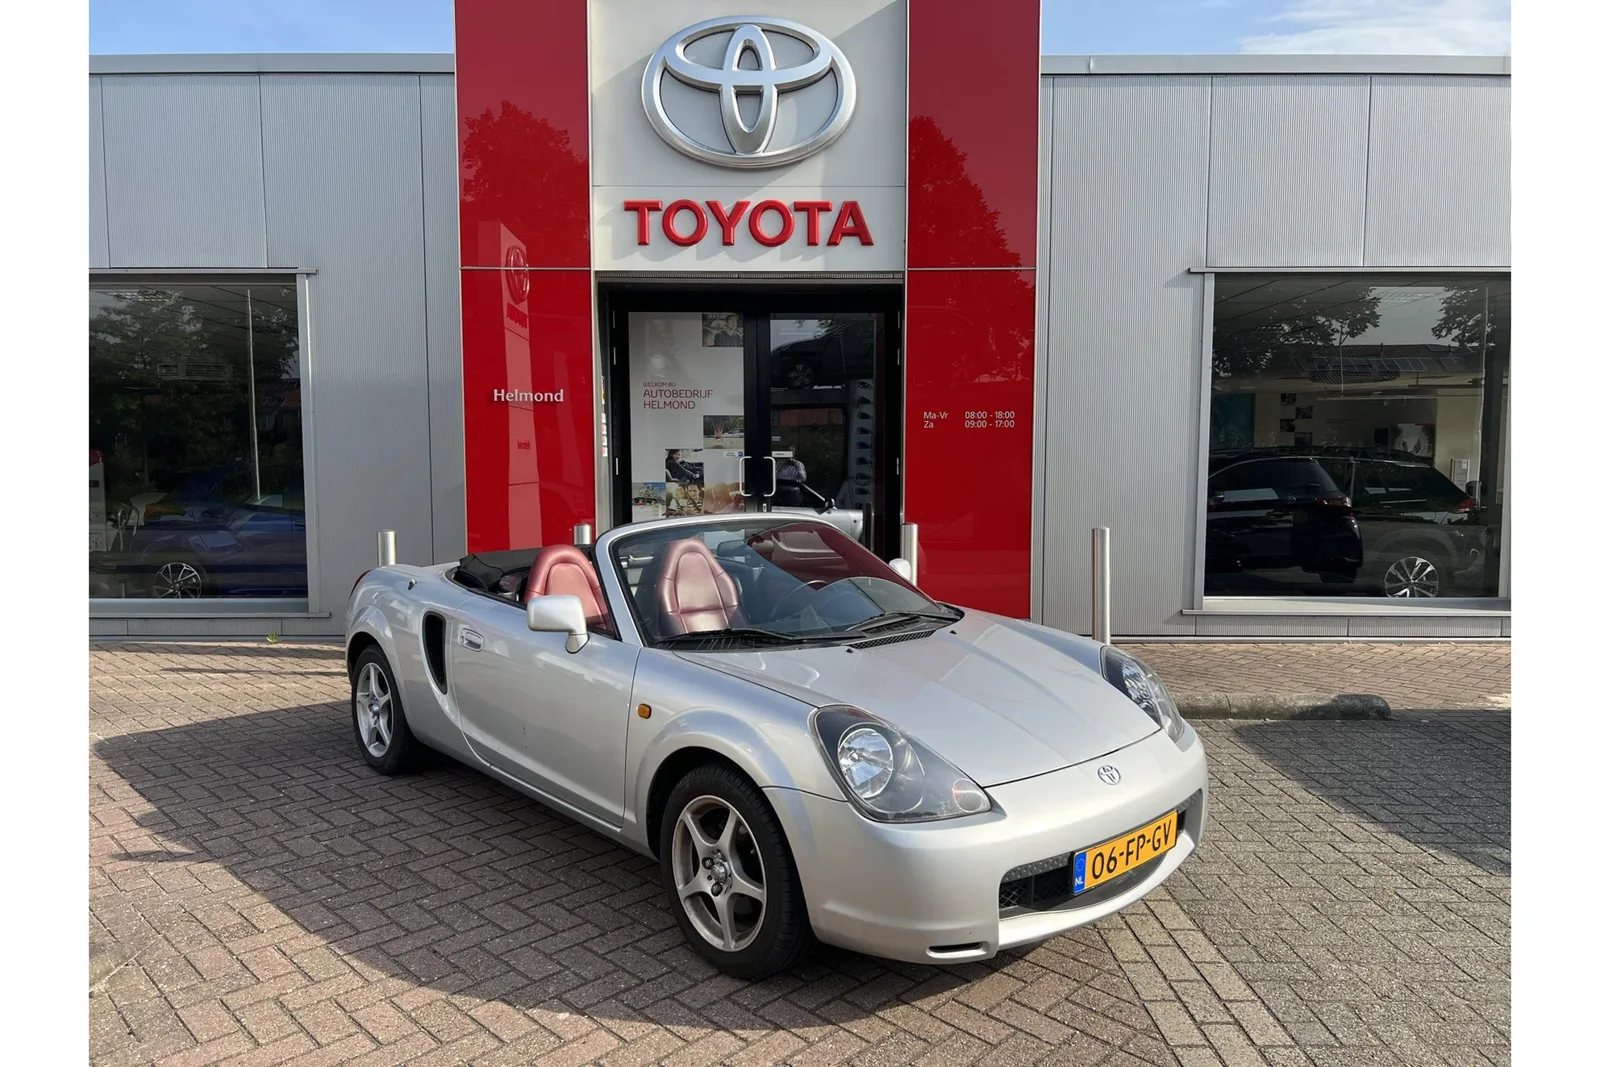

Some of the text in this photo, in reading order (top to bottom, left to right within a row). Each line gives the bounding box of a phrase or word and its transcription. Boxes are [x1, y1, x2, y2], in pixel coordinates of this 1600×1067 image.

[623, 199, 875, 248] TOYOTA
[493, 388, 564, 402] Helmond
[643, 389, 714, 399] AUTOBEDRIJF
[643, 400, 696, 410] HELMOND
[923, 411, 949, 420] Ma-Vr
[964, 411, 988, 420] 08:00
[994, 411, 1015, 420] 18:00
[923, 420, 934, 429] Za
[964, 420, 988, 428] 09:00
[994, 420, 1015, 428] 17:00
[1091, 819, 1172, 880] 06-FP-GV
[1074, 876, 1084, 886] NL
